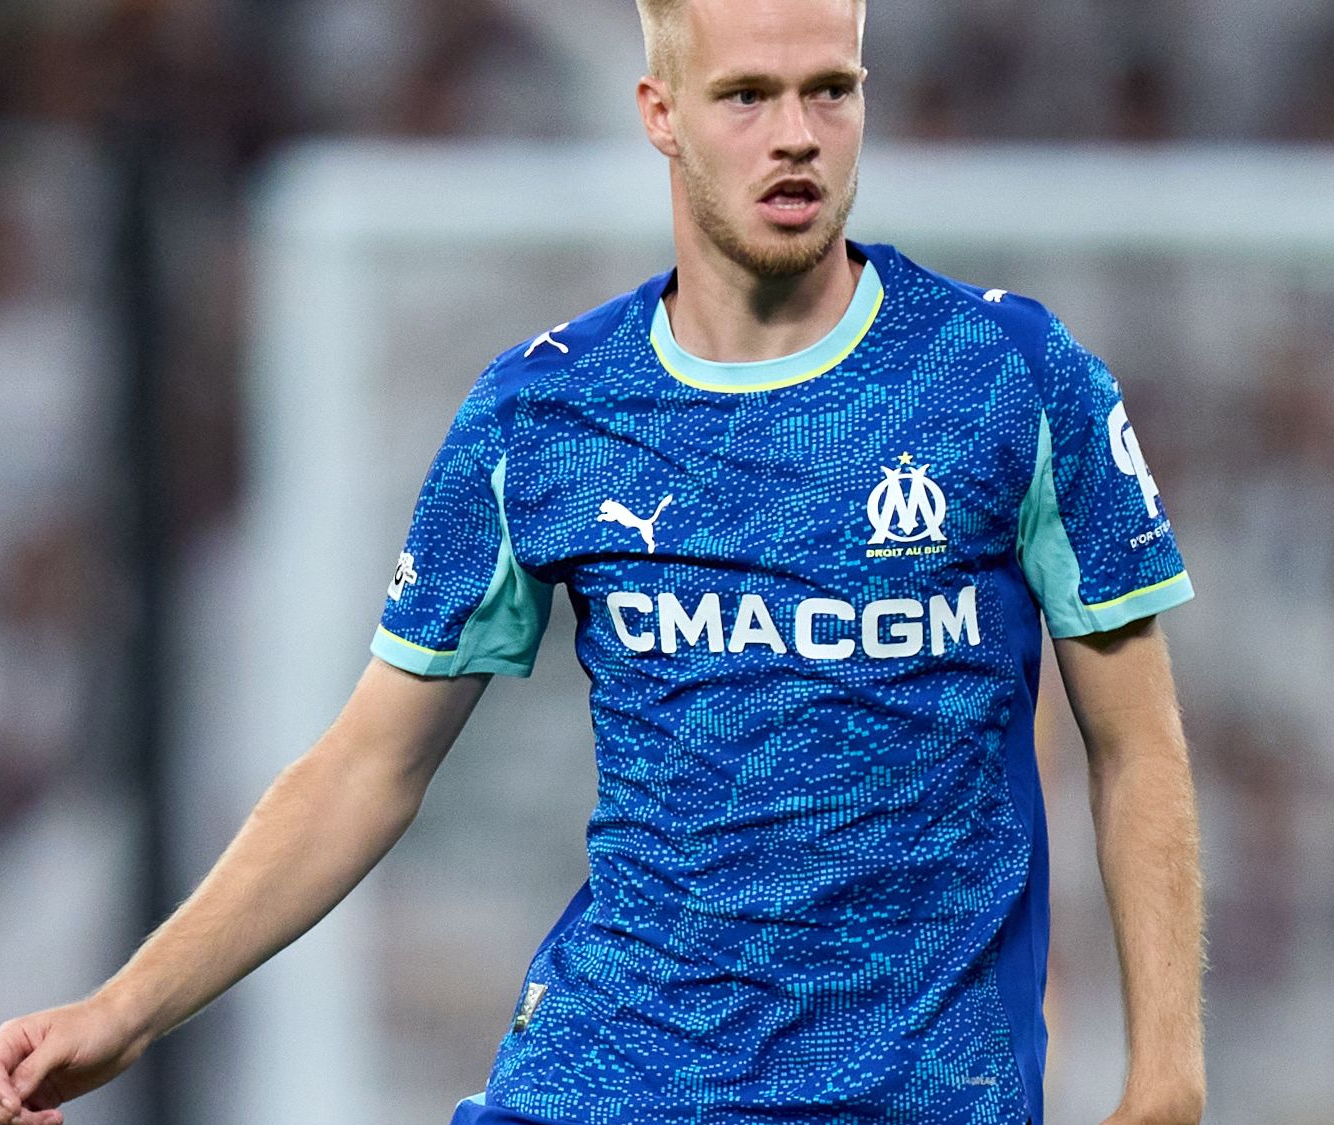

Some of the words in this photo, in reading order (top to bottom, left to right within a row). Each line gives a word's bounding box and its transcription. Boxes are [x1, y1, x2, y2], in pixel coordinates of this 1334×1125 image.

[865, 547, 904, 558] DROIT
[905, 546, 921, 556] AU
[924, 544, 947, 555] BUT
